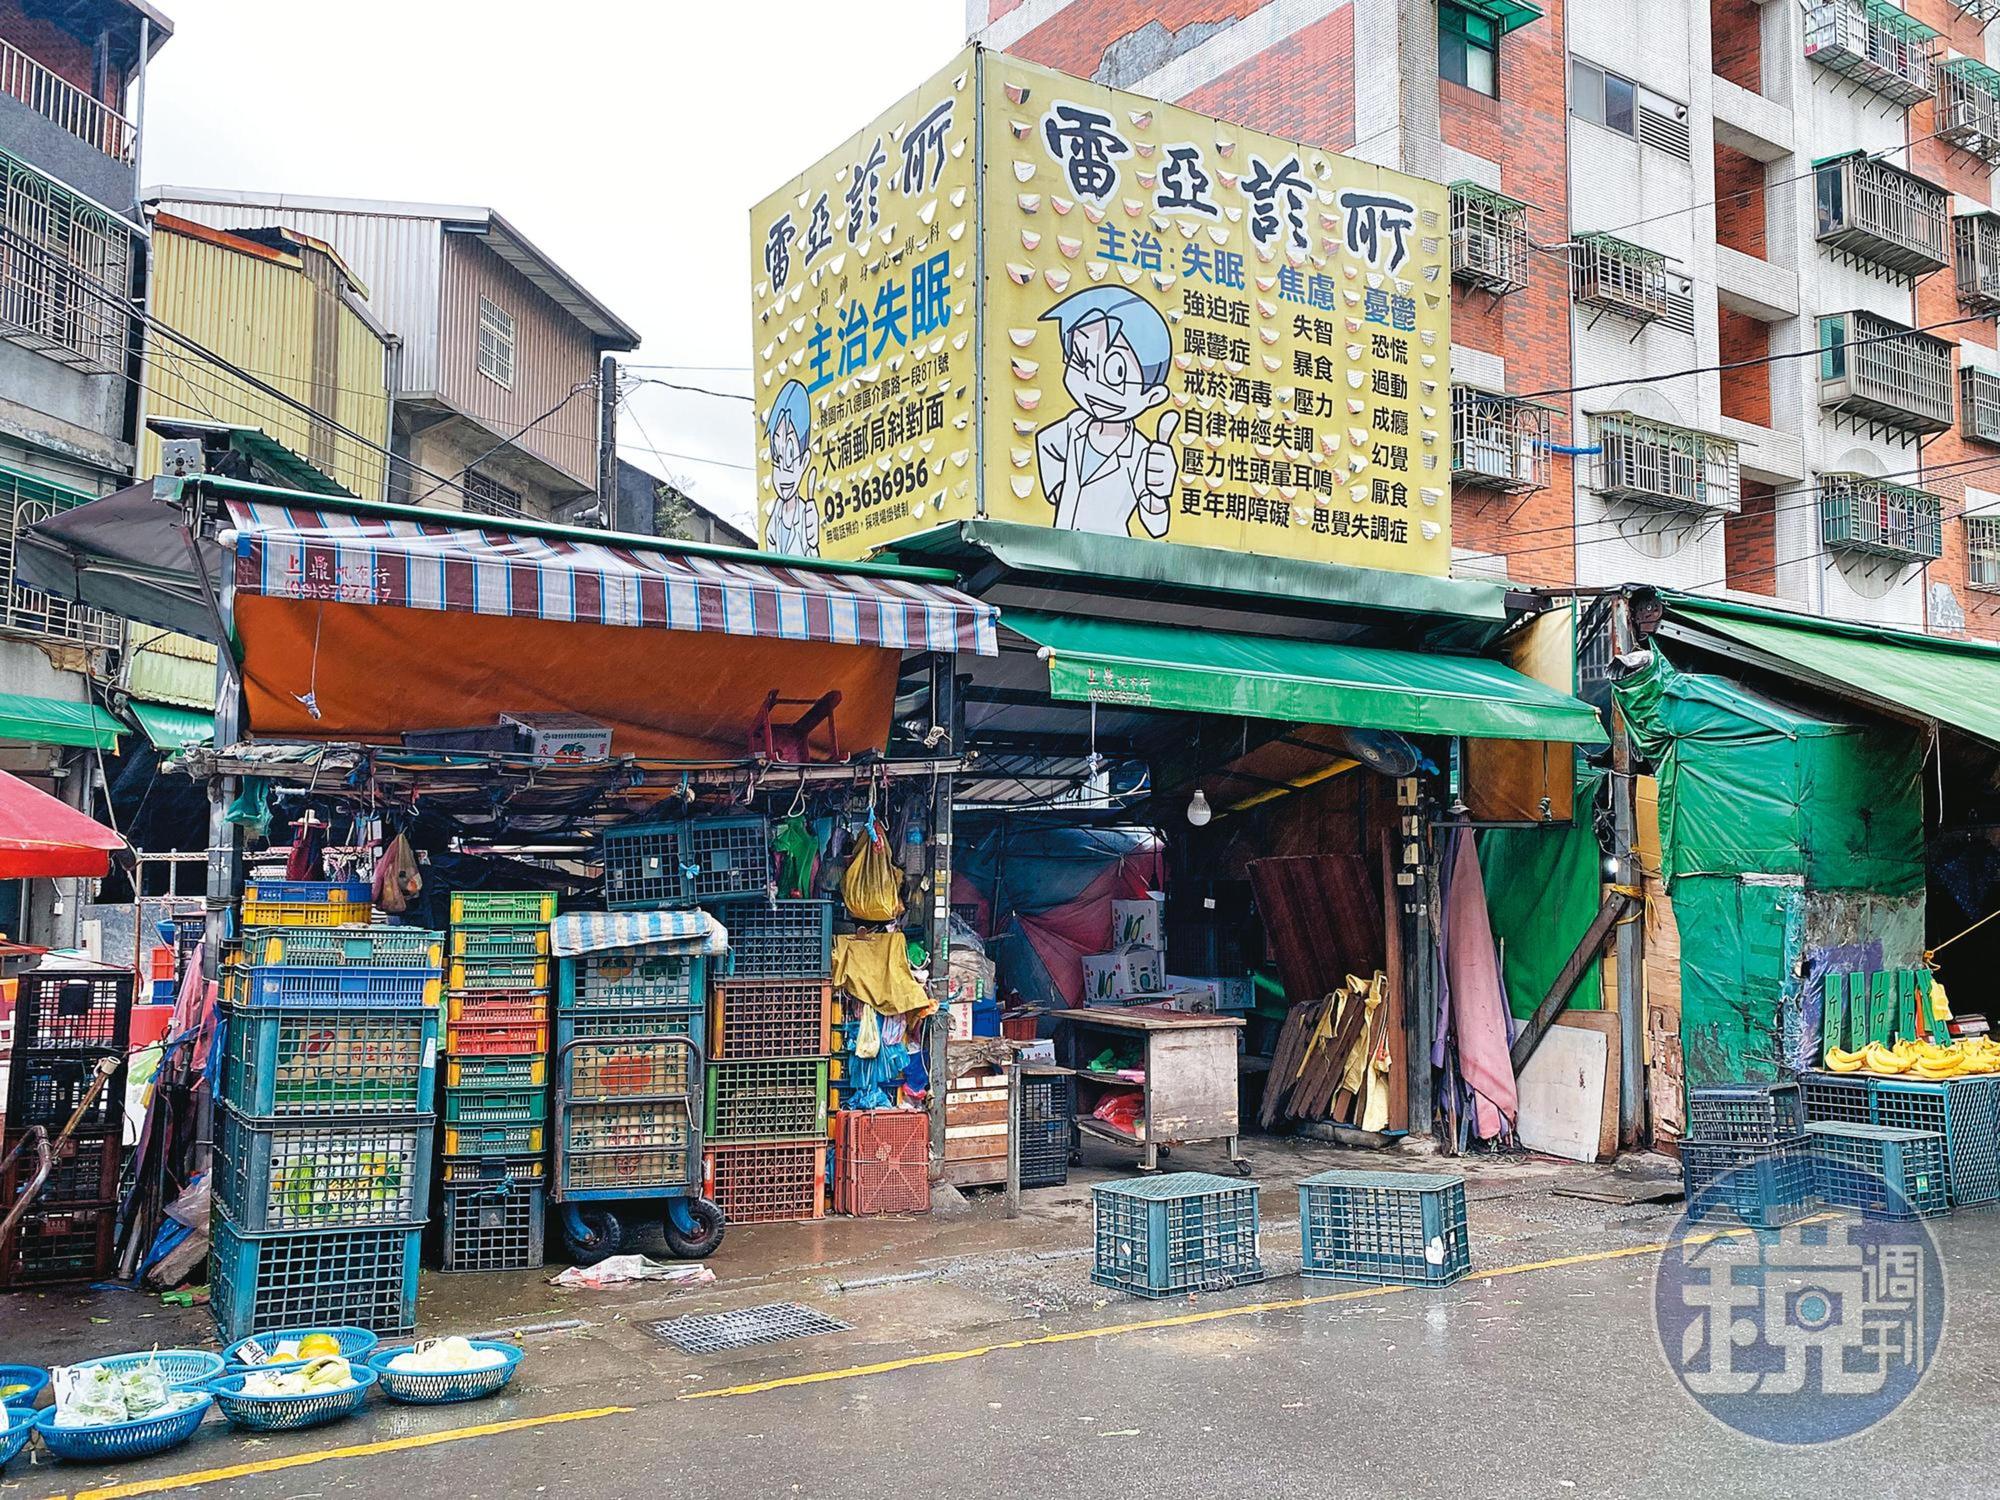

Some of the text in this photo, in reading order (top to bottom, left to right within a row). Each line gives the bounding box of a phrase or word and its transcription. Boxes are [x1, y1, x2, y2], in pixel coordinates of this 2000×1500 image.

[765, 100, 954, 293] 雷亞診所
[1045, 106, 1414, 272] 雷亞診所
[1183, 288, 1251, 328] 強迫症
[1277, 265, 1336, 313] 焦慮
[1363, 284, 1418, 333] 憂鬱
[807, 249, 952, 394] 主治失眠
[1293, 314, 1334, 346] 失智
[1183, 327, 1251, 367] 躁鬱症
[1293, 350, 1334, 383] 暴食
[1371, 333, 1409, 365] 恐慌
[1183, 370, 1273, 408] 戒菸酒毒
[1293, 387, 1334, 418] 壓力
[1371, 369, 1409, 400] 過動
[822, 391, 945, 477] 大湳郵局斜對面
[1183, 408, 1315, 454] 自律神經失調
[1372, 406, 1409, 437] 成癮
[1181, 446, 1334, 497] 壓力性頭暈耳鳴
[1371, 442, 1409, 473] 幻覺
[824, 457, 929, 523] 03-3636956
[1180, 487, 1291, 529] 更年期障礙
[1371, 478, 1409, 509] 厭食
[1311, 506, 1409, 545] 思覺失調症
